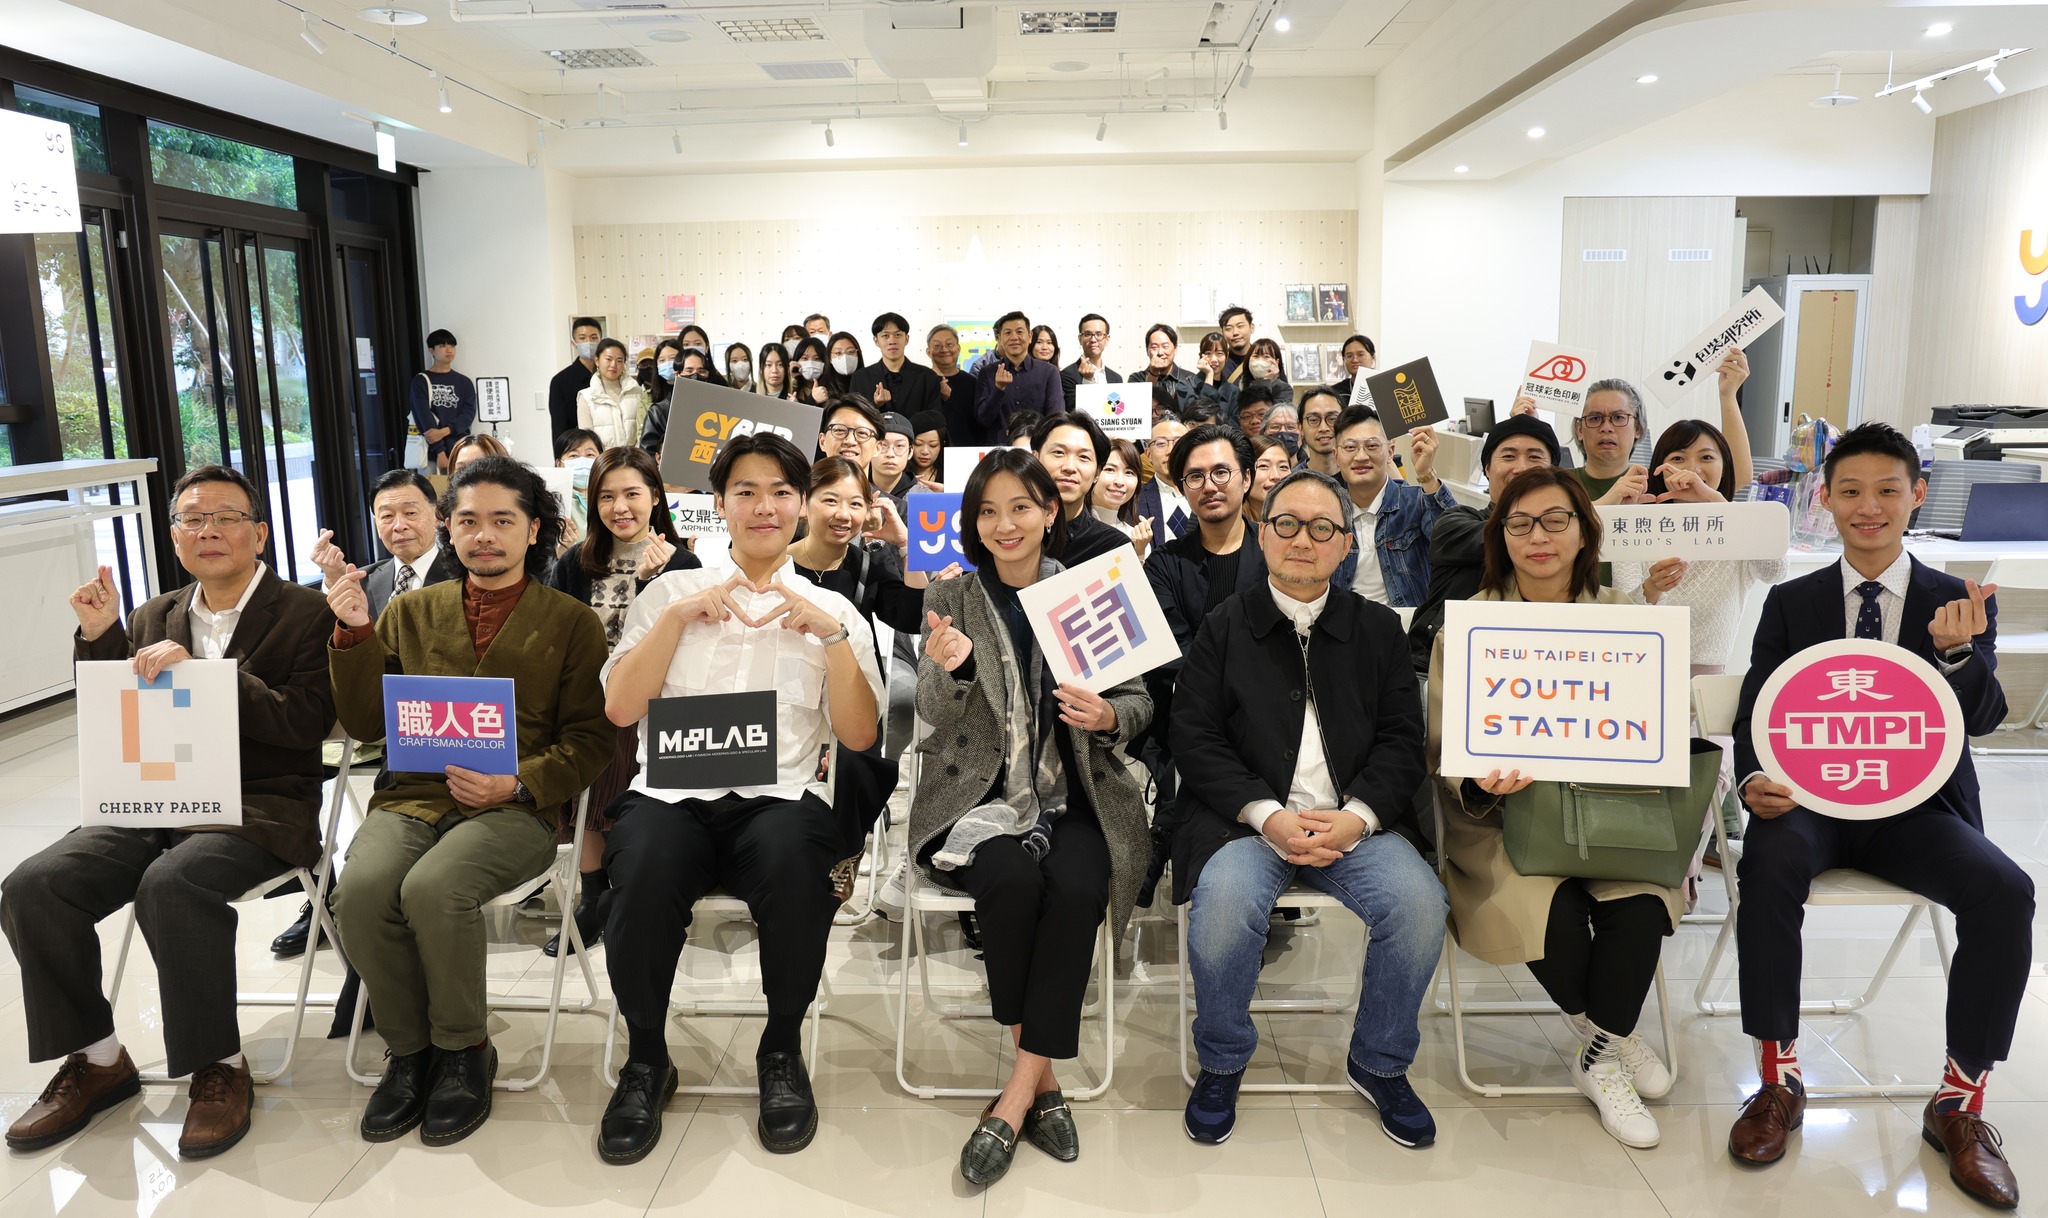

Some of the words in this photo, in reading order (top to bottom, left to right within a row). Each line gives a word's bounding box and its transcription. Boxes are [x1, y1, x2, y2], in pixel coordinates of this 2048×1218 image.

[1525, 382, 1580, 402] 冠球彩色印刷
[1121, 418, 1142, 426] SYUAN
[1404, 413, 1427, 424] INTAO
[680, 525, 713, 533] ARPHIC
[1612, 515, 1724, 534] 東煦色研所
[1694, 537, 1725, 546] LAB
[1485, 648, 1528, 660] NEW
[1534, 650, 1595, 662] TAIPEI
[1602, 651, 1646, 664] CITY
[1485, 677, 1610, 702] YOUTH
[1817, 668, 1894, 701] 東
[397, 700, 505, 738] 職人色
[1484, 715, 1647, 741] STATION
[1789, 716, 1922, 745] TMPI
[398, 737, 506, 750] CRAFTSMAN-COLOR
[1821, 759, 1889, 791] 明
[99, 802, 164, 814] CHERRY
[170, 802, 222, 814] PAPER
